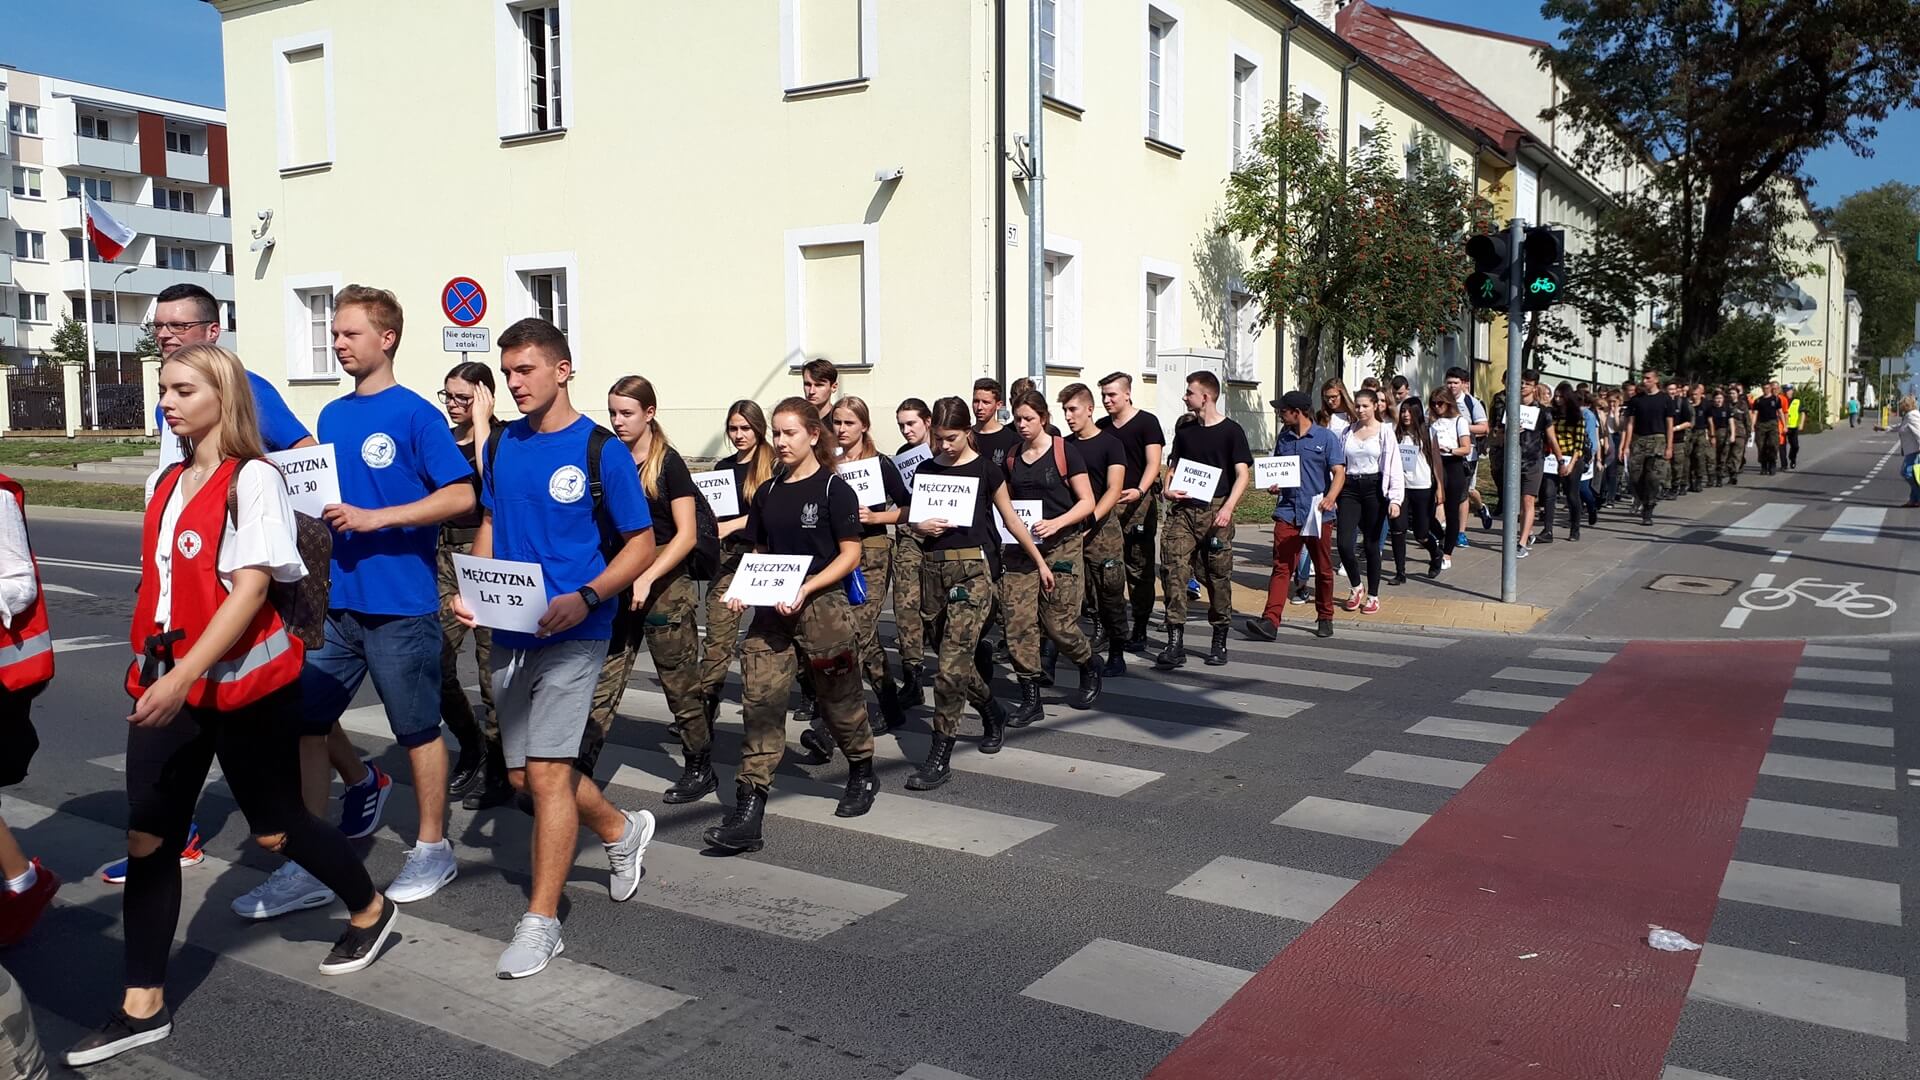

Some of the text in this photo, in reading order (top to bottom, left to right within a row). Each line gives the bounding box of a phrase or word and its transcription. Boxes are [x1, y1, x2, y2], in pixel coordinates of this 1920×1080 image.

[461, 332, 485, 340] dotyczy
[279, 457, 329, 476] ŻCZYZNA
[897, 454, 925, 471] KOBIETA
[841, 468, 870, 481] BIETA
[1183, 466, 1211, 480] KOBIETA
[696, 477, 730, 489] CZYZNA
[857, 482, 869, 492] 35
[1183, 475, 1207, 488] LAT 42
[288, 480, 318, 496] AT 30
[918, 482, 972, 494] MĘŻCZYZNA
[712, 492, 722, 500] 37
[927, 497, 958, 507] LAT 41
[743, 562, 801, 574] MĘŻCZYZNA
[461, 567, 537, 588] MĘŻCZYZNA
[750, 577, 785, 587] LAT 38
[479, 590, 524, 607] LAT 32
